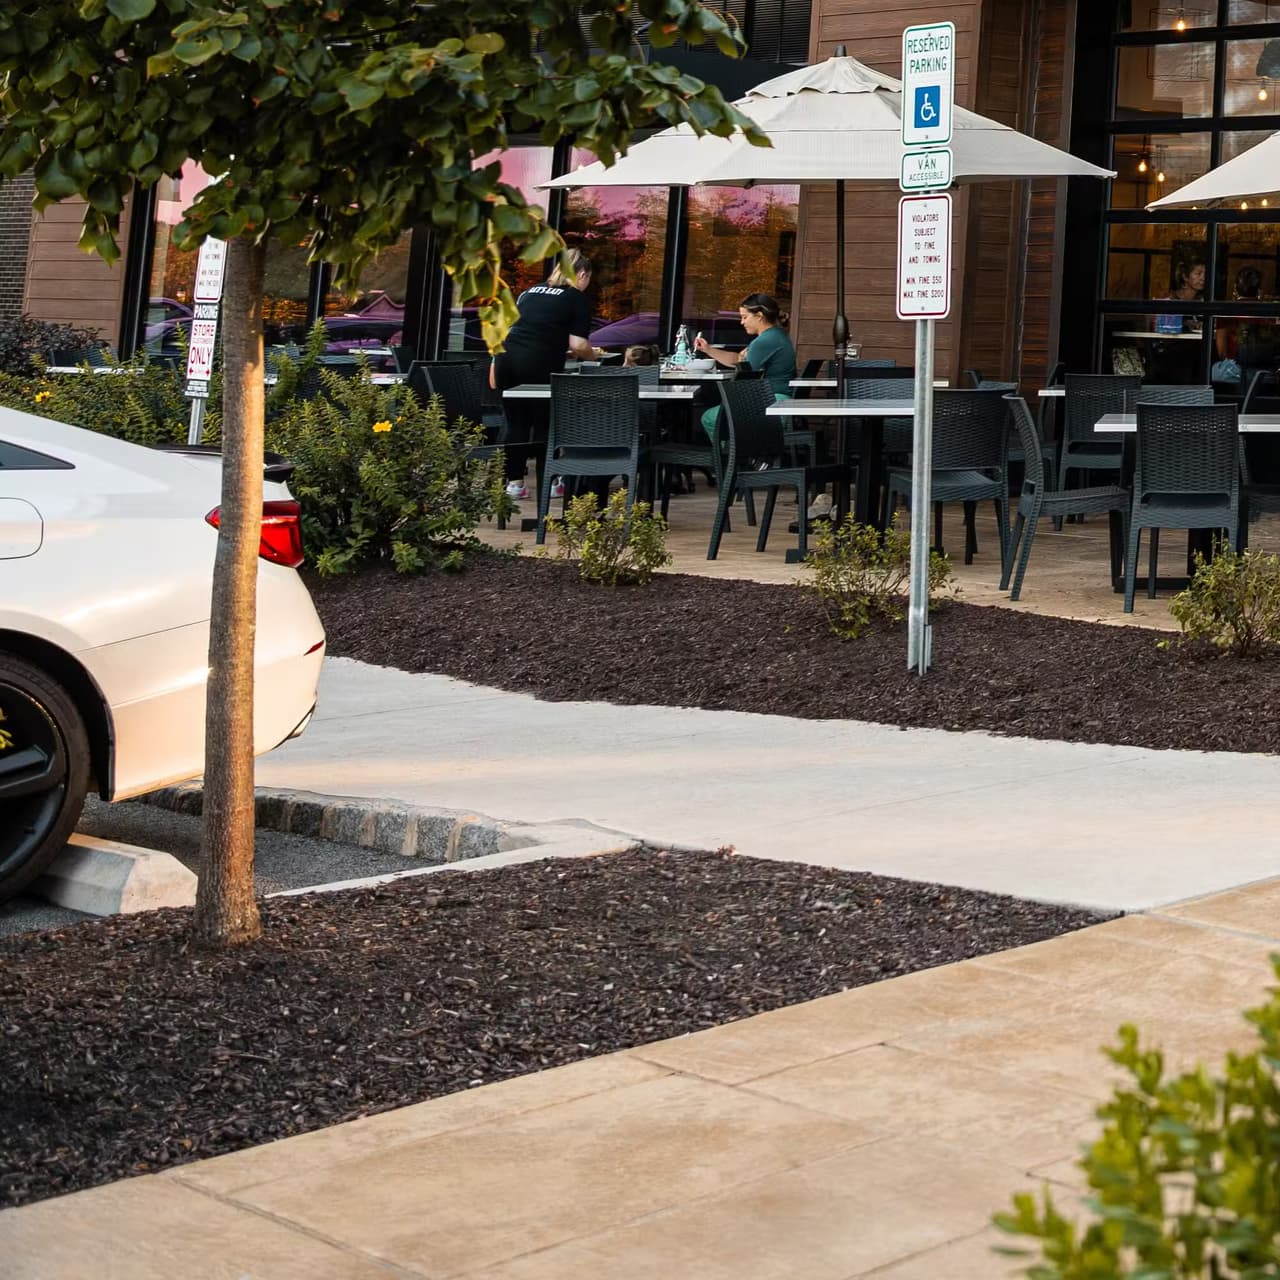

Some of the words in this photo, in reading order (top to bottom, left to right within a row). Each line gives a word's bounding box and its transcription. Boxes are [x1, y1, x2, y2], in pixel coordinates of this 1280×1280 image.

[907, 35, 950, 54] RESERVED
[910, 56, 947, 73] PARKING
[918, 158, 937, 170] VAN
[909, 171, 944, 181] ACCESSIBLE
[912, 214, 939, 222] VIOLATORS
[914, 227, 936, 236] SUBJECT
[914, 241, 921, 250] TO
[924, 241, 935, 250] FINE
[909, 256, 919, 264] AND
[923, 255, 941, 263] TOWING
[919, 275, 930, 284] FINE
[917, 290, 928, 298] FINE
[194, 304, 218, 319] PARKING
[193, 324, 215, 337] STORE
[190, 346, 212, 365] ONLY
